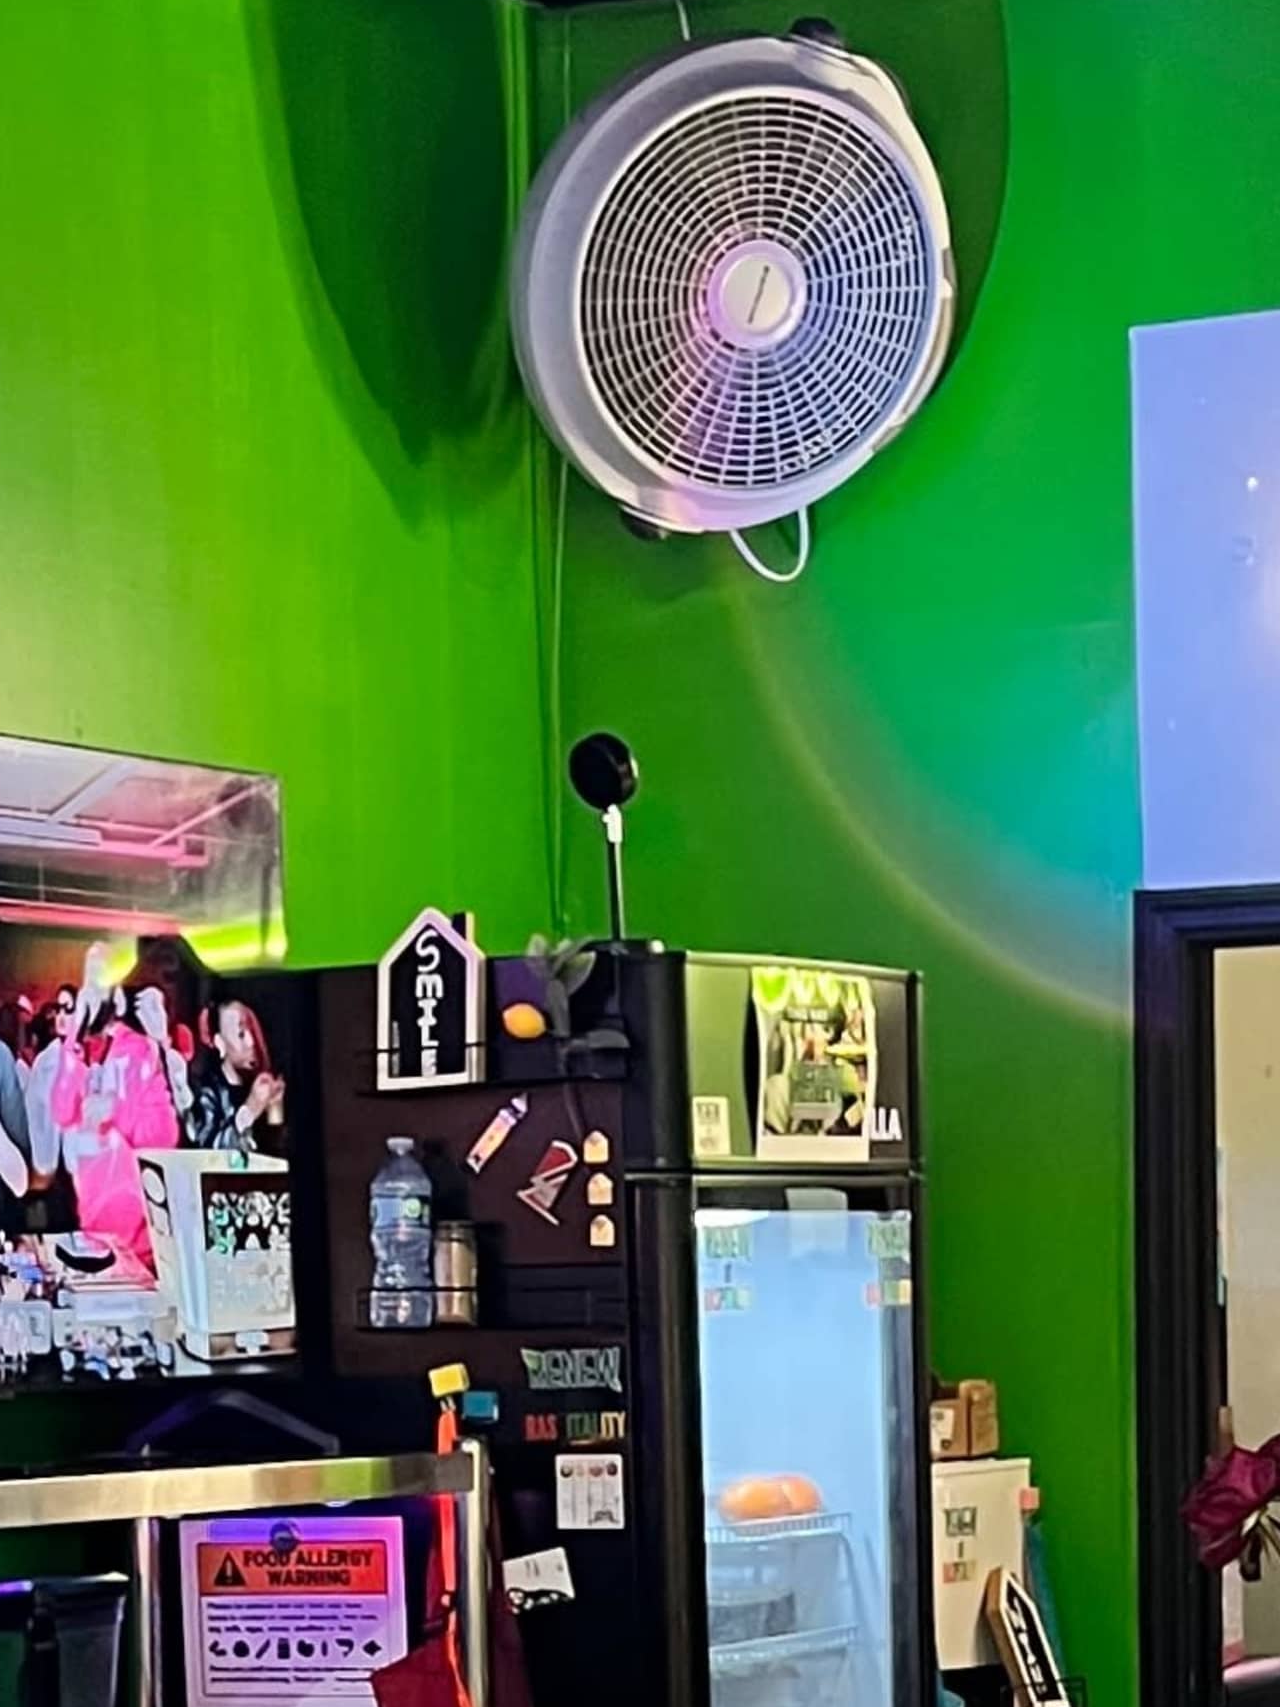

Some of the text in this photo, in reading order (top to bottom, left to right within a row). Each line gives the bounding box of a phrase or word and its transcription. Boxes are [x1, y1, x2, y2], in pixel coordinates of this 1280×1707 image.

[243, 1549, 373, 1568] FOOD ALLERGY
[267, 1570, 351, 1586] WARNING
